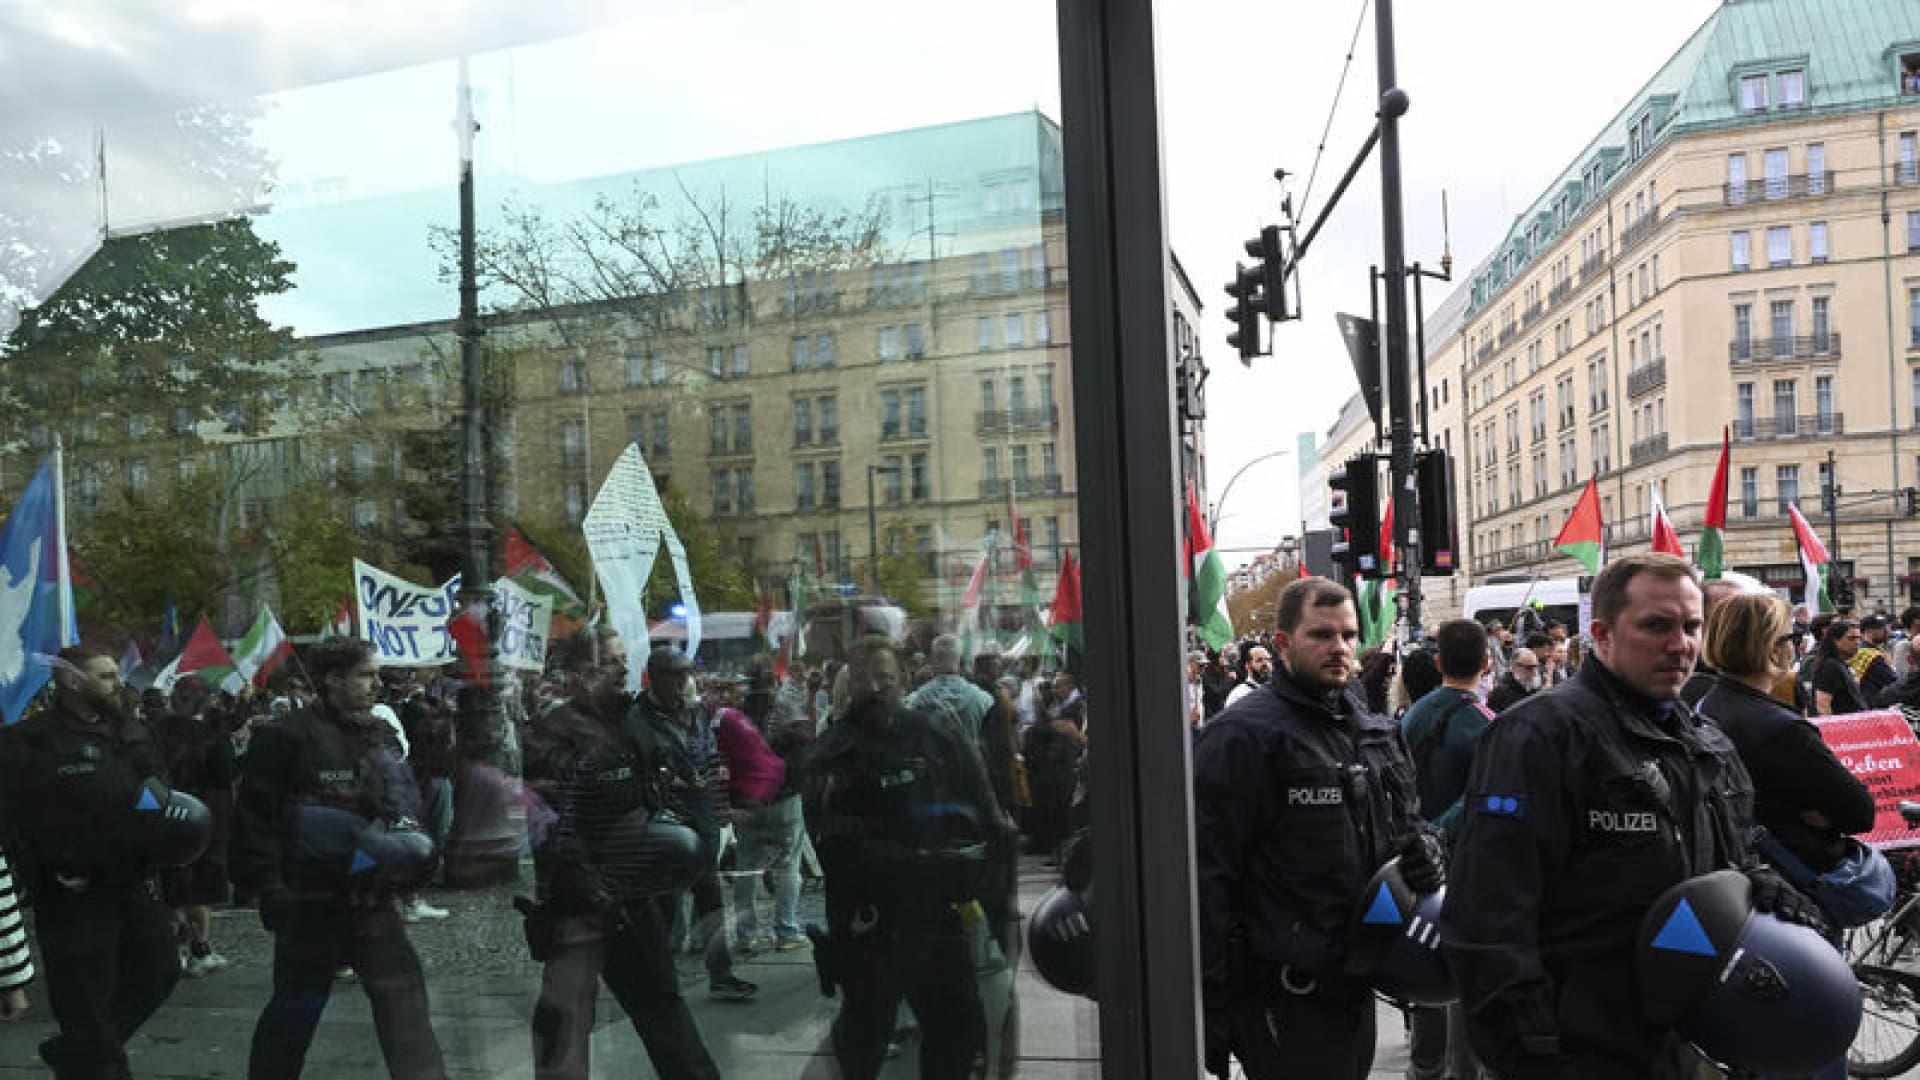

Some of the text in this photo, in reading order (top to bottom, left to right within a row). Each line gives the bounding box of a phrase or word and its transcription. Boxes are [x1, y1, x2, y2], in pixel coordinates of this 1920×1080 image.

[367, 618, 420, 659] NOT
[1288, 787, 1343, 805] POLIZEI
[1588, 809, 1657, 832] POLIZEI
